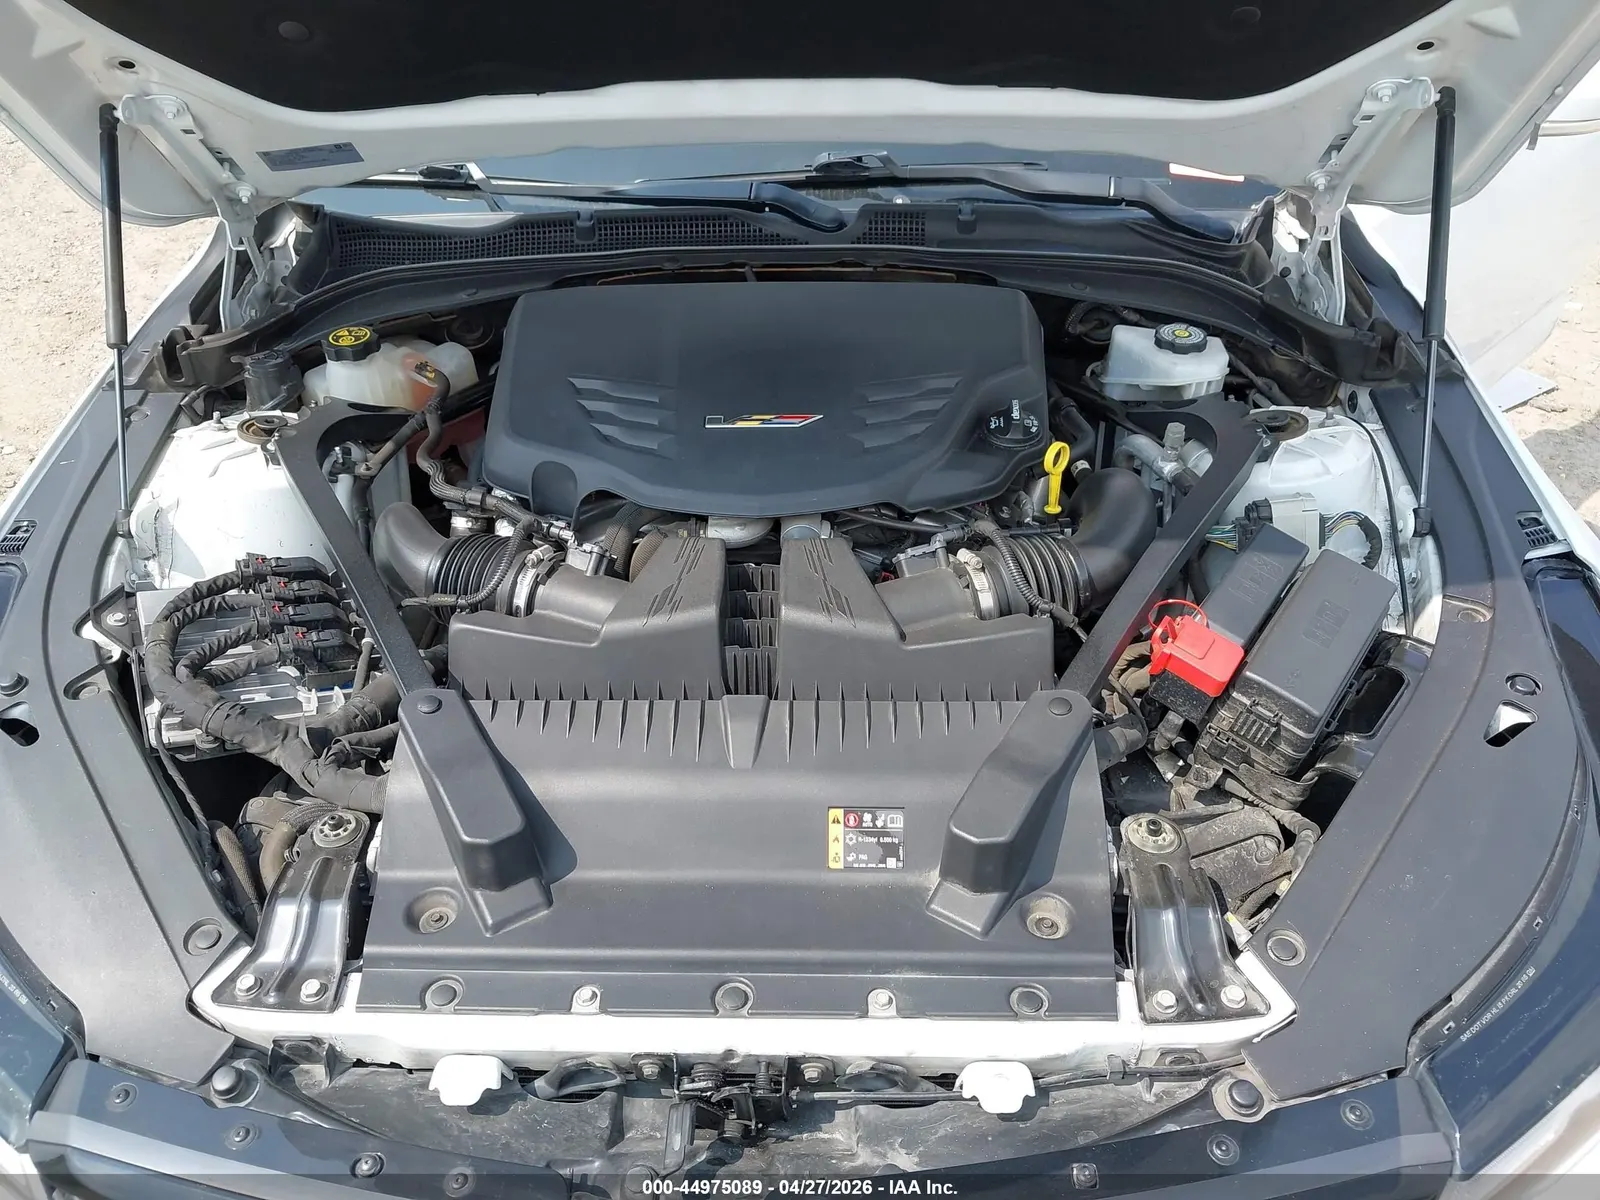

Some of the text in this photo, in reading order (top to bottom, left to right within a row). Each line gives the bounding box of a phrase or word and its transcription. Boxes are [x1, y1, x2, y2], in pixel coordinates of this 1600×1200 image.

[1460, 1030, 1472, 1042] SAE
[1470, 1021, 1482, 1034] DOT
[1480, 1012, 1493, 1024] VOR
